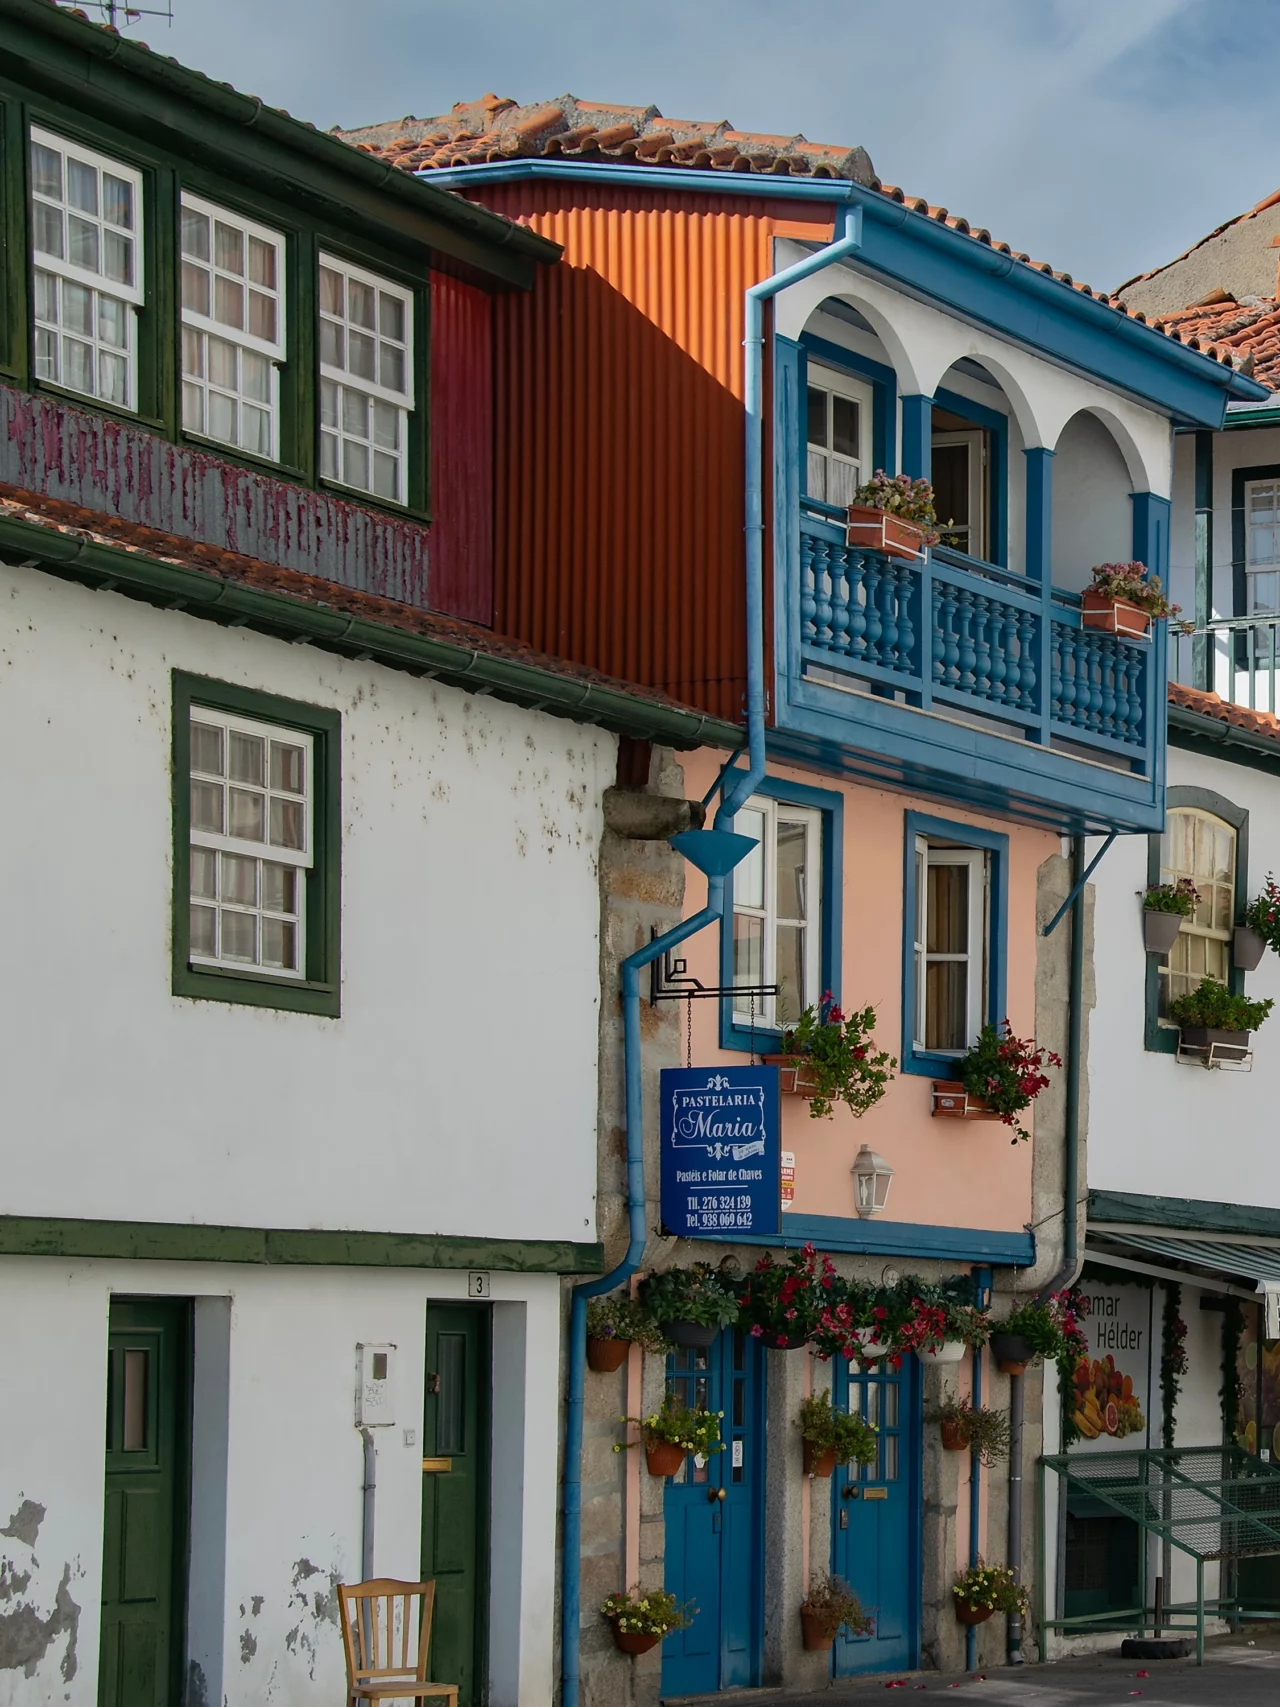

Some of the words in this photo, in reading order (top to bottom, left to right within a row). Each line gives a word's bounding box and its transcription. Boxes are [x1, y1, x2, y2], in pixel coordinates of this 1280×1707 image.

[682, 1094, 755, 1107] PASTELARIA
[679, 1109, 758, 1139] Maria
[676, 1170, 701, 1182] Pastéis
[702, 1172, 707, 1181] e
[708, 1170, 726, 1181] Folar
[728, 1169, 737, 1180] de
[739, 1168, 762, 1180] Chaves
[702, 1196, 718, 1209] 276
[720, 1195, 735, 1209] 324
[737, 1195, 751, 1209] 139
[686, 1213, 700, 1227] Tel.
[702, 1213, 718, 1226] 938
[720, 1213, 735, 1226] 069
[737, 1212, 752, 1226] 642
[476, 1276, 483, 1294] 3
[1097, 1321, 1143, 1350] Hélder
